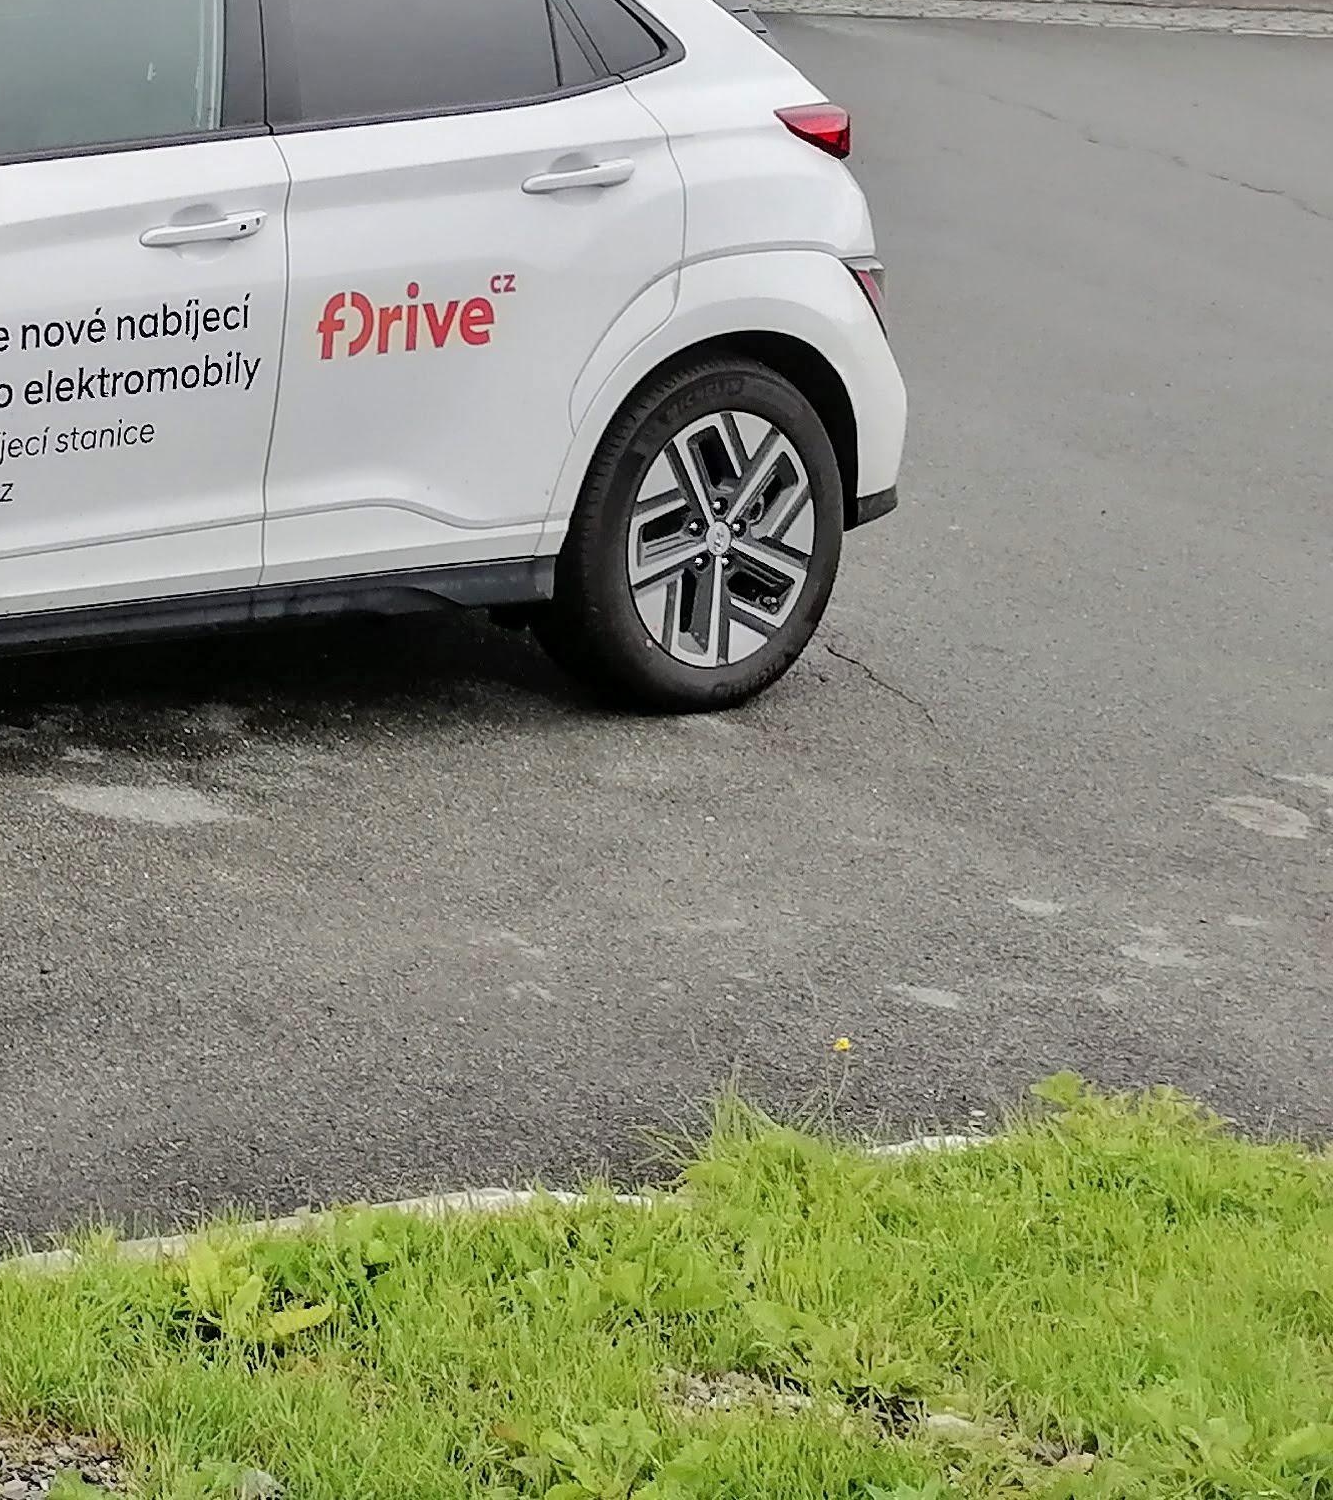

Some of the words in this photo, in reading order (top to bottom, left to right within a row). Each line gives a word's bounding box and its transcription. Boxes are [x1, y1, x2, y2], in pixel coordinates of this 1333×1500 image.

[20, 307, 107, 351] nové
[116, 293, 251, 341] nabíjecí
[23, 351, 261, 404] elektromobily
[54, 418, 156, 453] stanice
